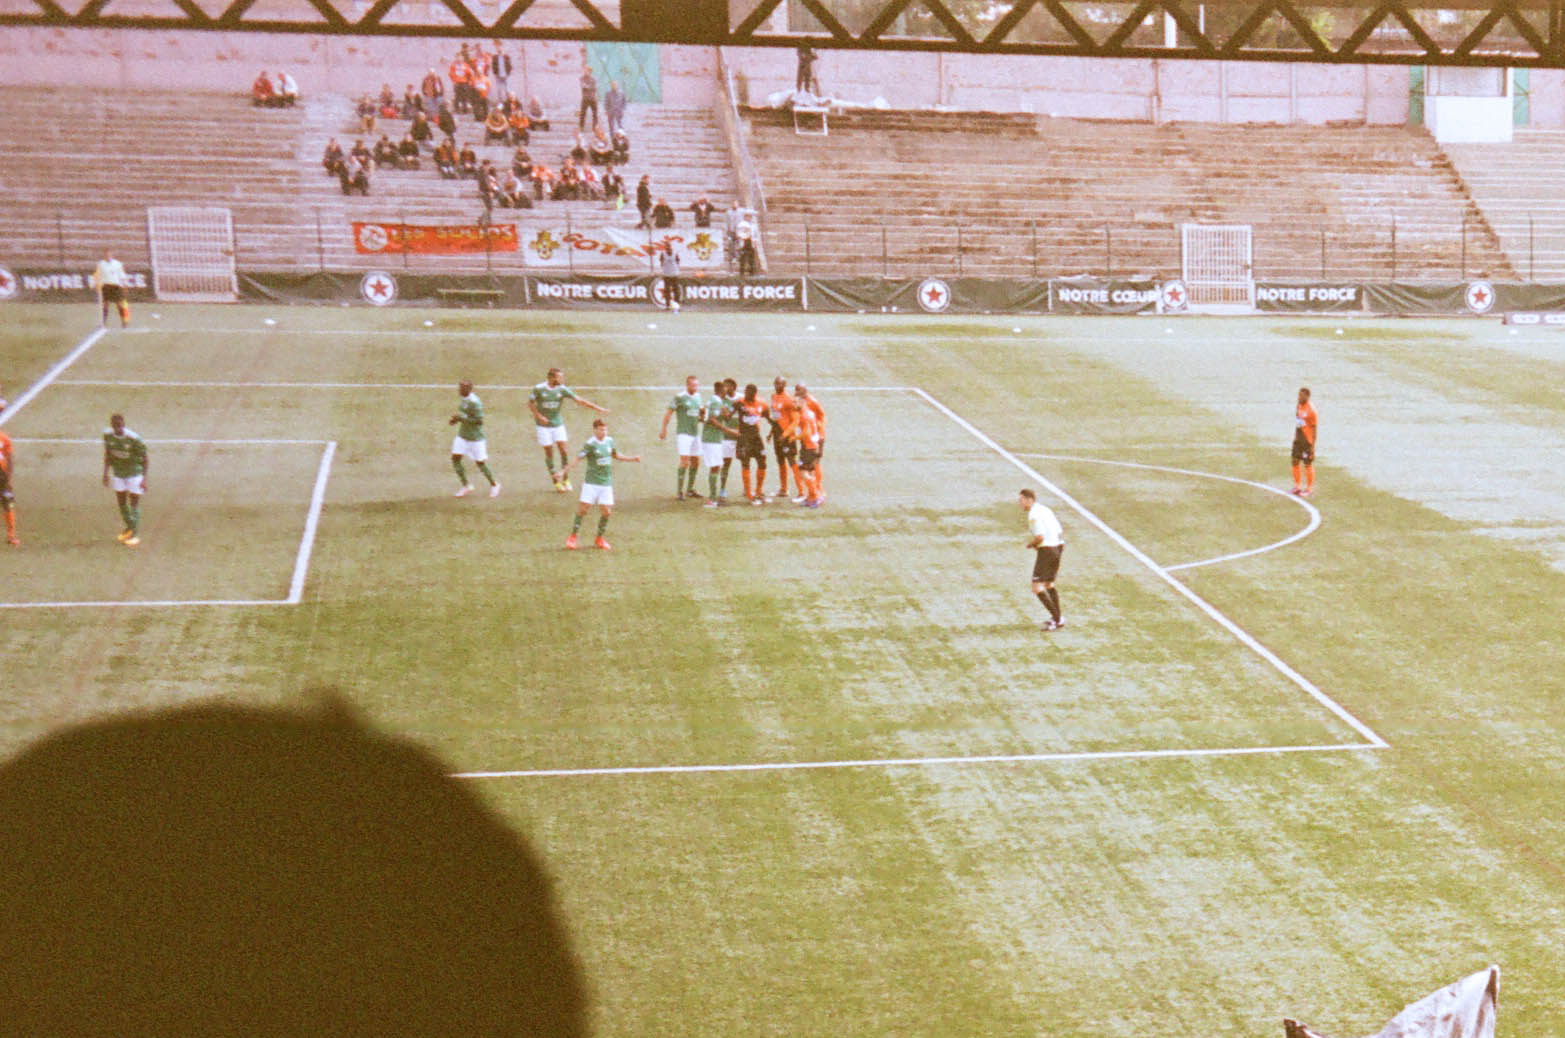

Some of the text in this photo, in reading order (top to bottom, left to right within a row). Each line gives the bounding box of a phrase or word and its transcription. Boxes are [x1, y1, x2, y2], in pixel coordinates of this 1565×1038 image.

[23, 274, 83, 289] NOTRE
[537, 283, 647, 298] NOTRE CŒUR
[686, 285, 796, 299] NOTRE FORCE
[1059, 289, 1109, 302] NOTRE
[1257, 287, 1356, 301] NOTRE FORCE
